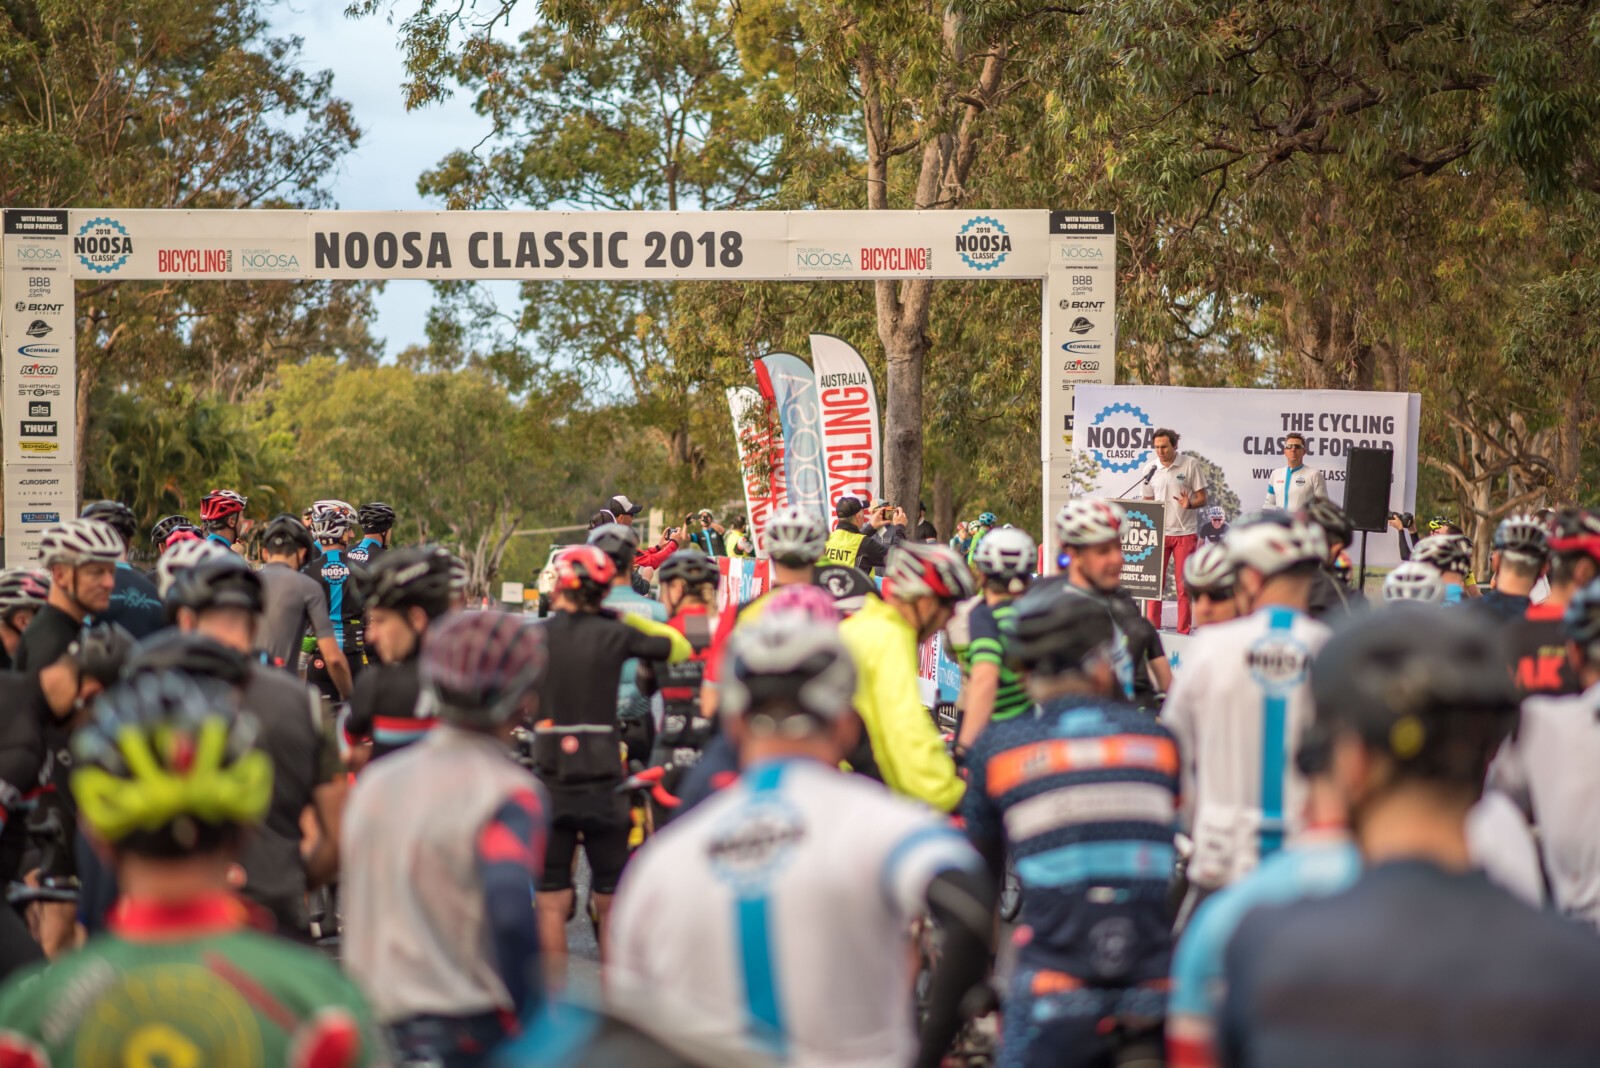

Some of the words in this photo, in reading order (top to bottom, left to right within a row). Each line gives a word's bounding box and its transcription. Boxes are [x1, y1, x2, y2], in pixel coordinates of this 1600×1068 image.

[74, 236, 133, 254] NOOSA
[315, 232, 452, 269] NOOSA
[468, 231, 628, 269] CLASSIC
[644, 231, 743, 268] 2018
[956, 235, 1012, 252] NOOSA
[18, 248, 62, 258] NOOSA
[797, 253, 853, 266] NOOSA
[861, 248, 926, 271] BICYCLING
[1062, 248, 1103, 258] NOOSA
[158, 250, 226, 272] BICYCLING
[242, 255, 299, 268] NOOSA
[29, 277, 50, 287] BBB
[1072, 276, 1092, 285] BBB
[820, 372, 867, 388] AUSTRALIA
[24, 424, 54, 433] THULE
[1281, 413, 1314, 431] THE
[1319, 413, 1394, 434] CYCLING
[1087, 426, 1155, 449] NOOSA
[1243, 436, 1314, 456] CLASC
[1106, 450, 1135, 458] CLASSIC
[1120, 528, 1158, 546] OOSA
[347, 552, 369, 561] NOOSA
[321, 567, 350, 576] NOOSA
[1119, 573, 1140, 582] UGUST,
